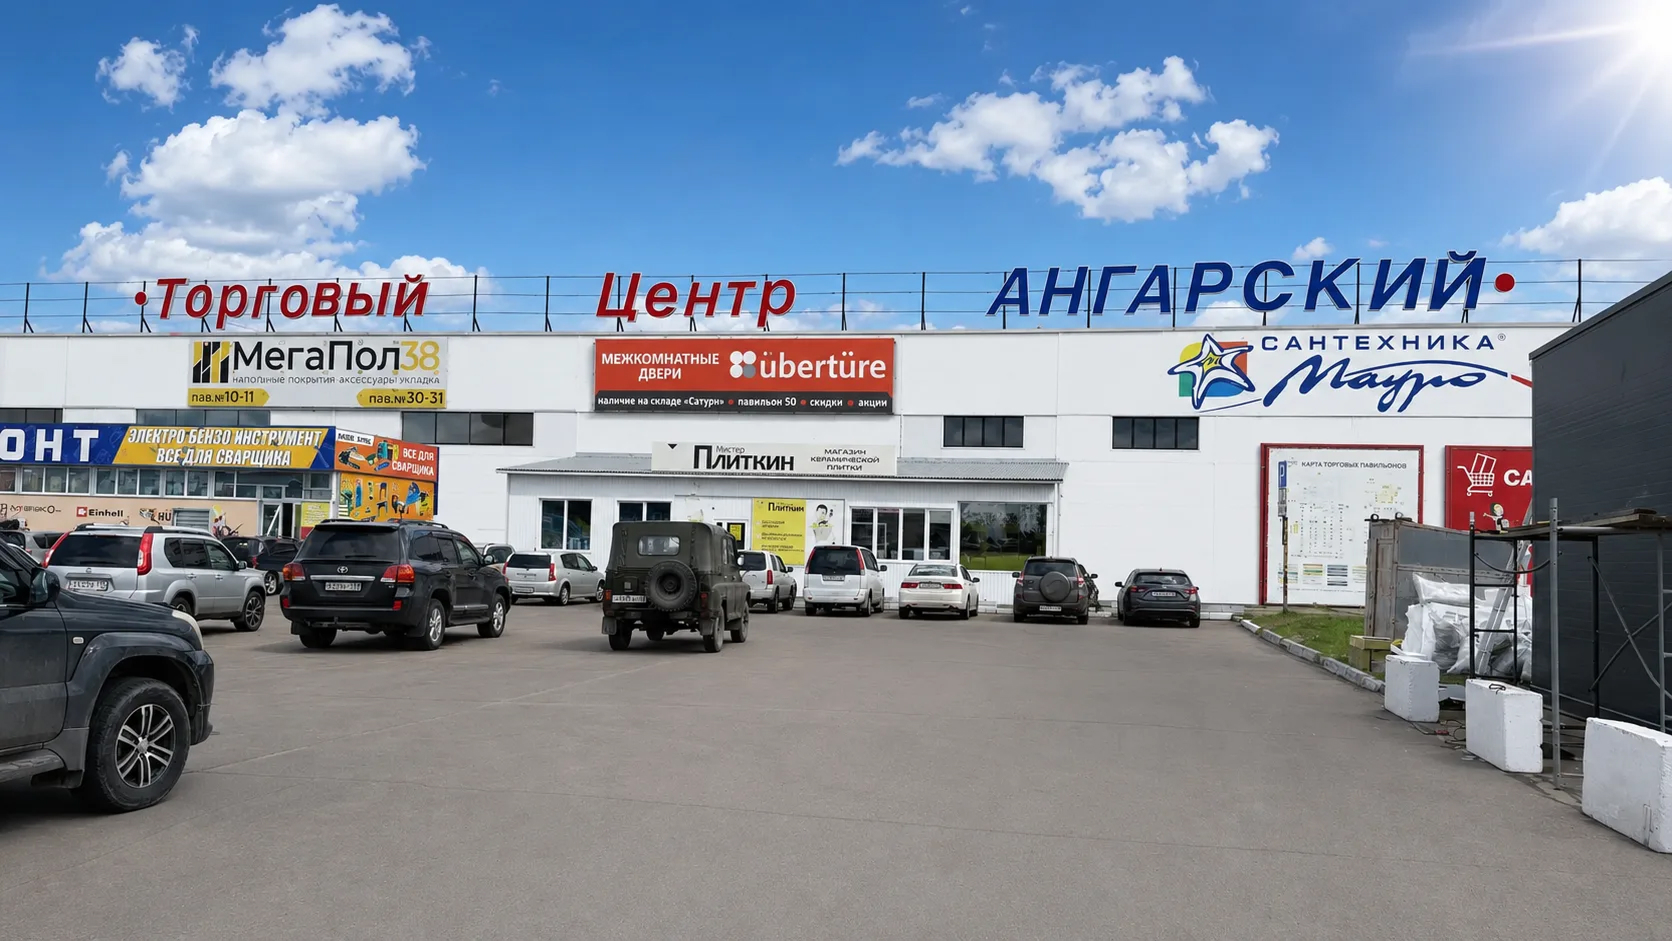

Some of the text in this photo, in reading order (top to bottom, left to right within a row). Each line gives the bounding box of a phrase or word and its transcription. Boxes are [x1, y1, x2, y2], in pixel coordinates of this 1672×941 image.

[156, 250, 1489, 330] Торговый Центр АНГАРСКИЙ
[1261, 335, 1495, 351] САНТЕХНИКА
[601, 353, 720, 366] МЕЖКОМНАТНЫЕ
[760, 350, 887, 380] übertüre
[638, 368, 682, 382] ДВЕРИ
[598, 397, 634, 406] наличие
[637, 397, 649, 406] на
[650, 397, 682, 407] складе
[684, 396, 725, 408] «Сатурн»
[737, 397, 782, 407] павильон
[809, 398, 843, 409] скидки
[858, 399, 888, 409] акции
[0, 428, 99, 462] ОНТ
[127, 428, 187, 445] ЭЛЕКТРО
[187, 428, 231, 445] БЕНЗО
[234, 430, 322, 447] ИНСТРУМЕНТ
[156, 447, 291, 468] ВСЕ ДЛЯ СВАРЩИКА
[403, 448, 434, 462] ВСЕ ДЛЯ
[693, 445, 795, 470] Плиткин
[715, 445, 746, 454] Мистер
[391, 461, 434, 476] СВАРЩИКА
[1280, 465, 1285, 486] P
[89, 508, 124, 518] Einhell
